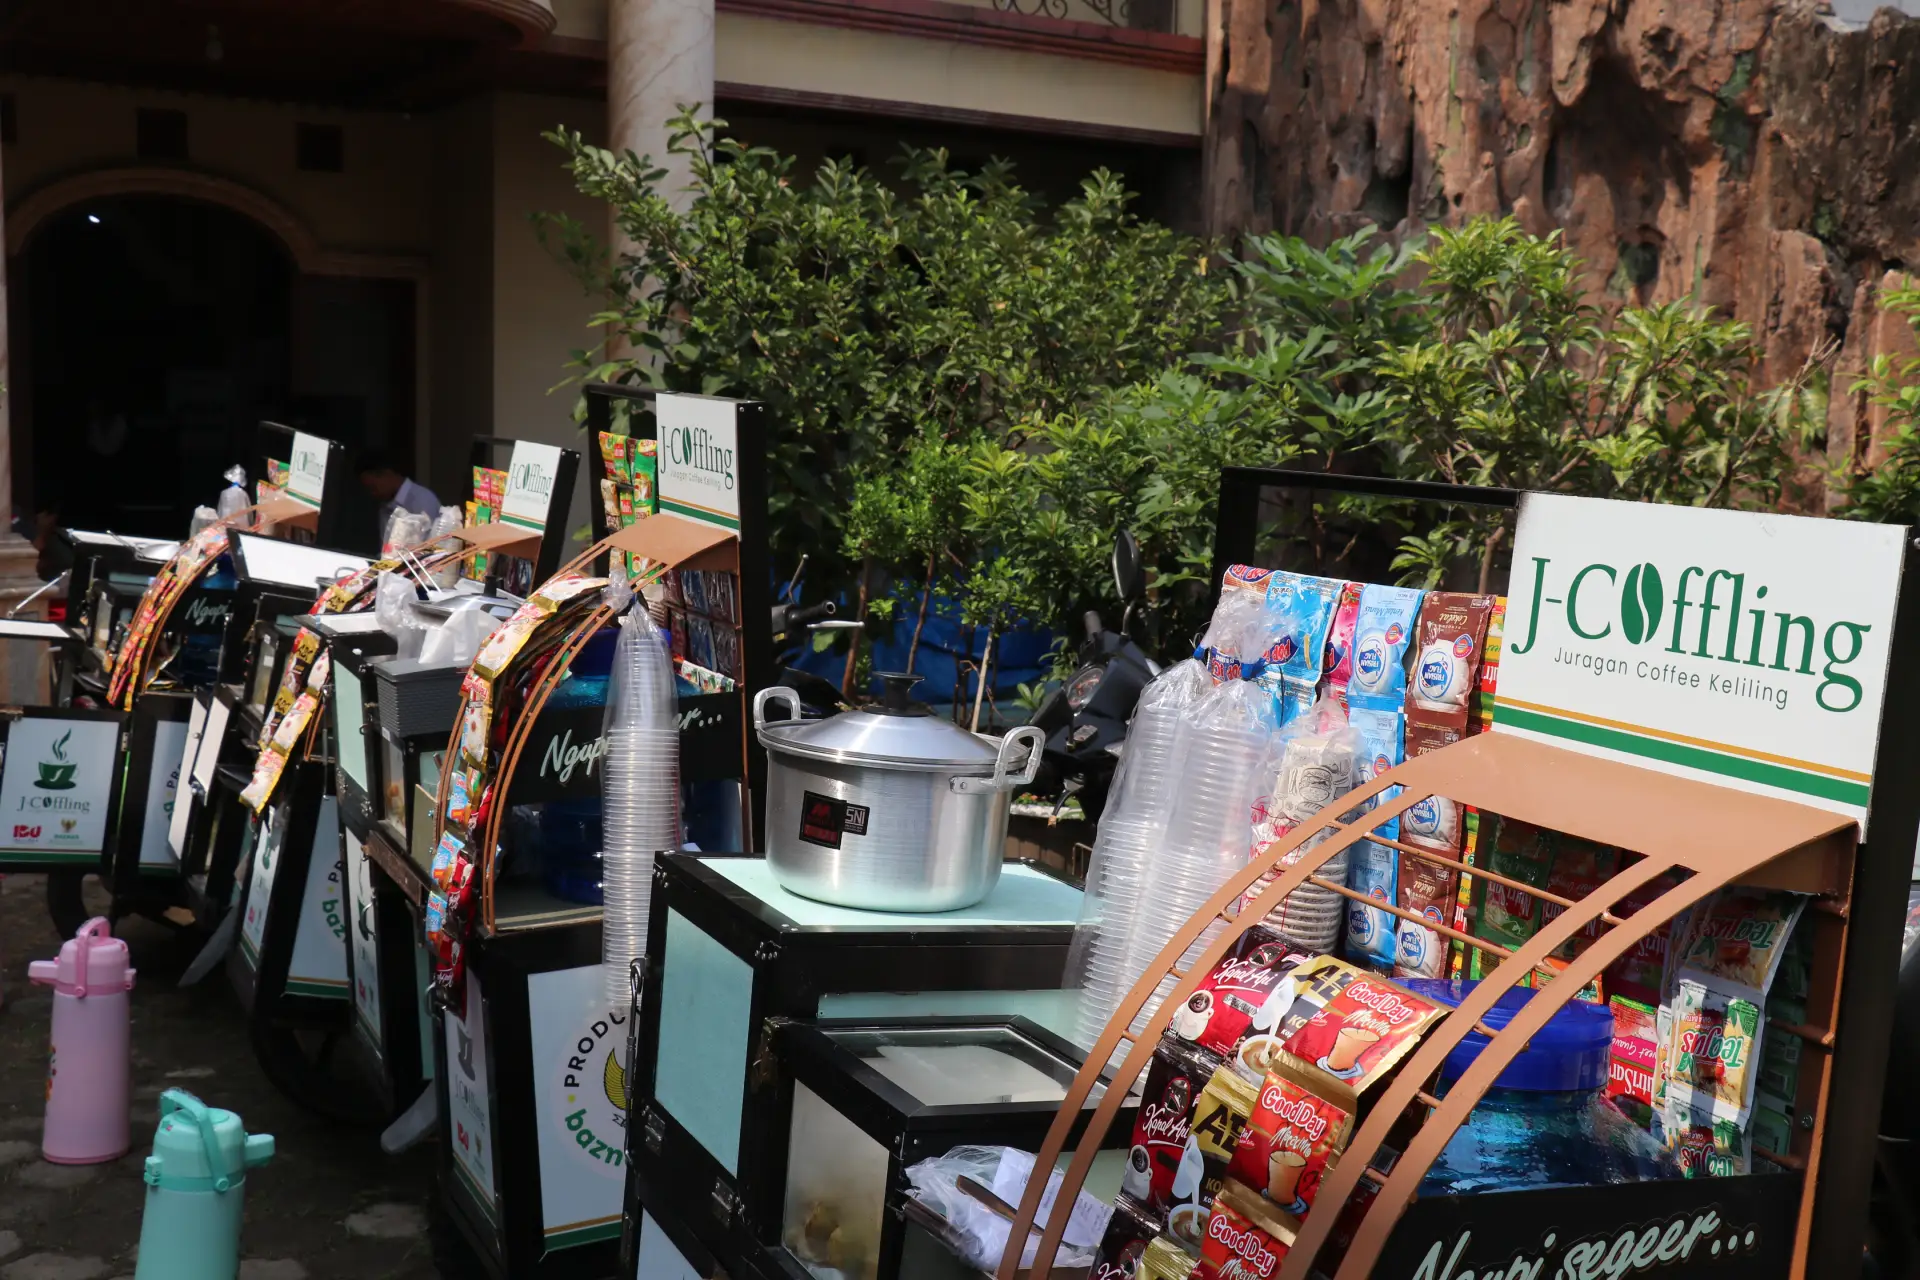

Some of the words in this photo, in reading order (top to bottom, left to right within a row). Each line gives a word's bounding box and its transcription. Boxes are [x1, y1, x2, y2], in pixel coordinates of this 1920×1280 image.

[1361, 659, 1381, 669] FRISIAN
[1424, 671, 1445, 682] FRISIAN
[1553, 646, 1629, 676] Juragan
[1636, 660, 1701, 689] Coffee
[1709, 674, 1790, 709] Keliling
[845, 807, 867, 827] SNI
[1680, 1025, 1744, 1068] Teajus
[1608, 1062, 1653, 1096] utriSar
[565, 1108, 624, 1167] bazn
